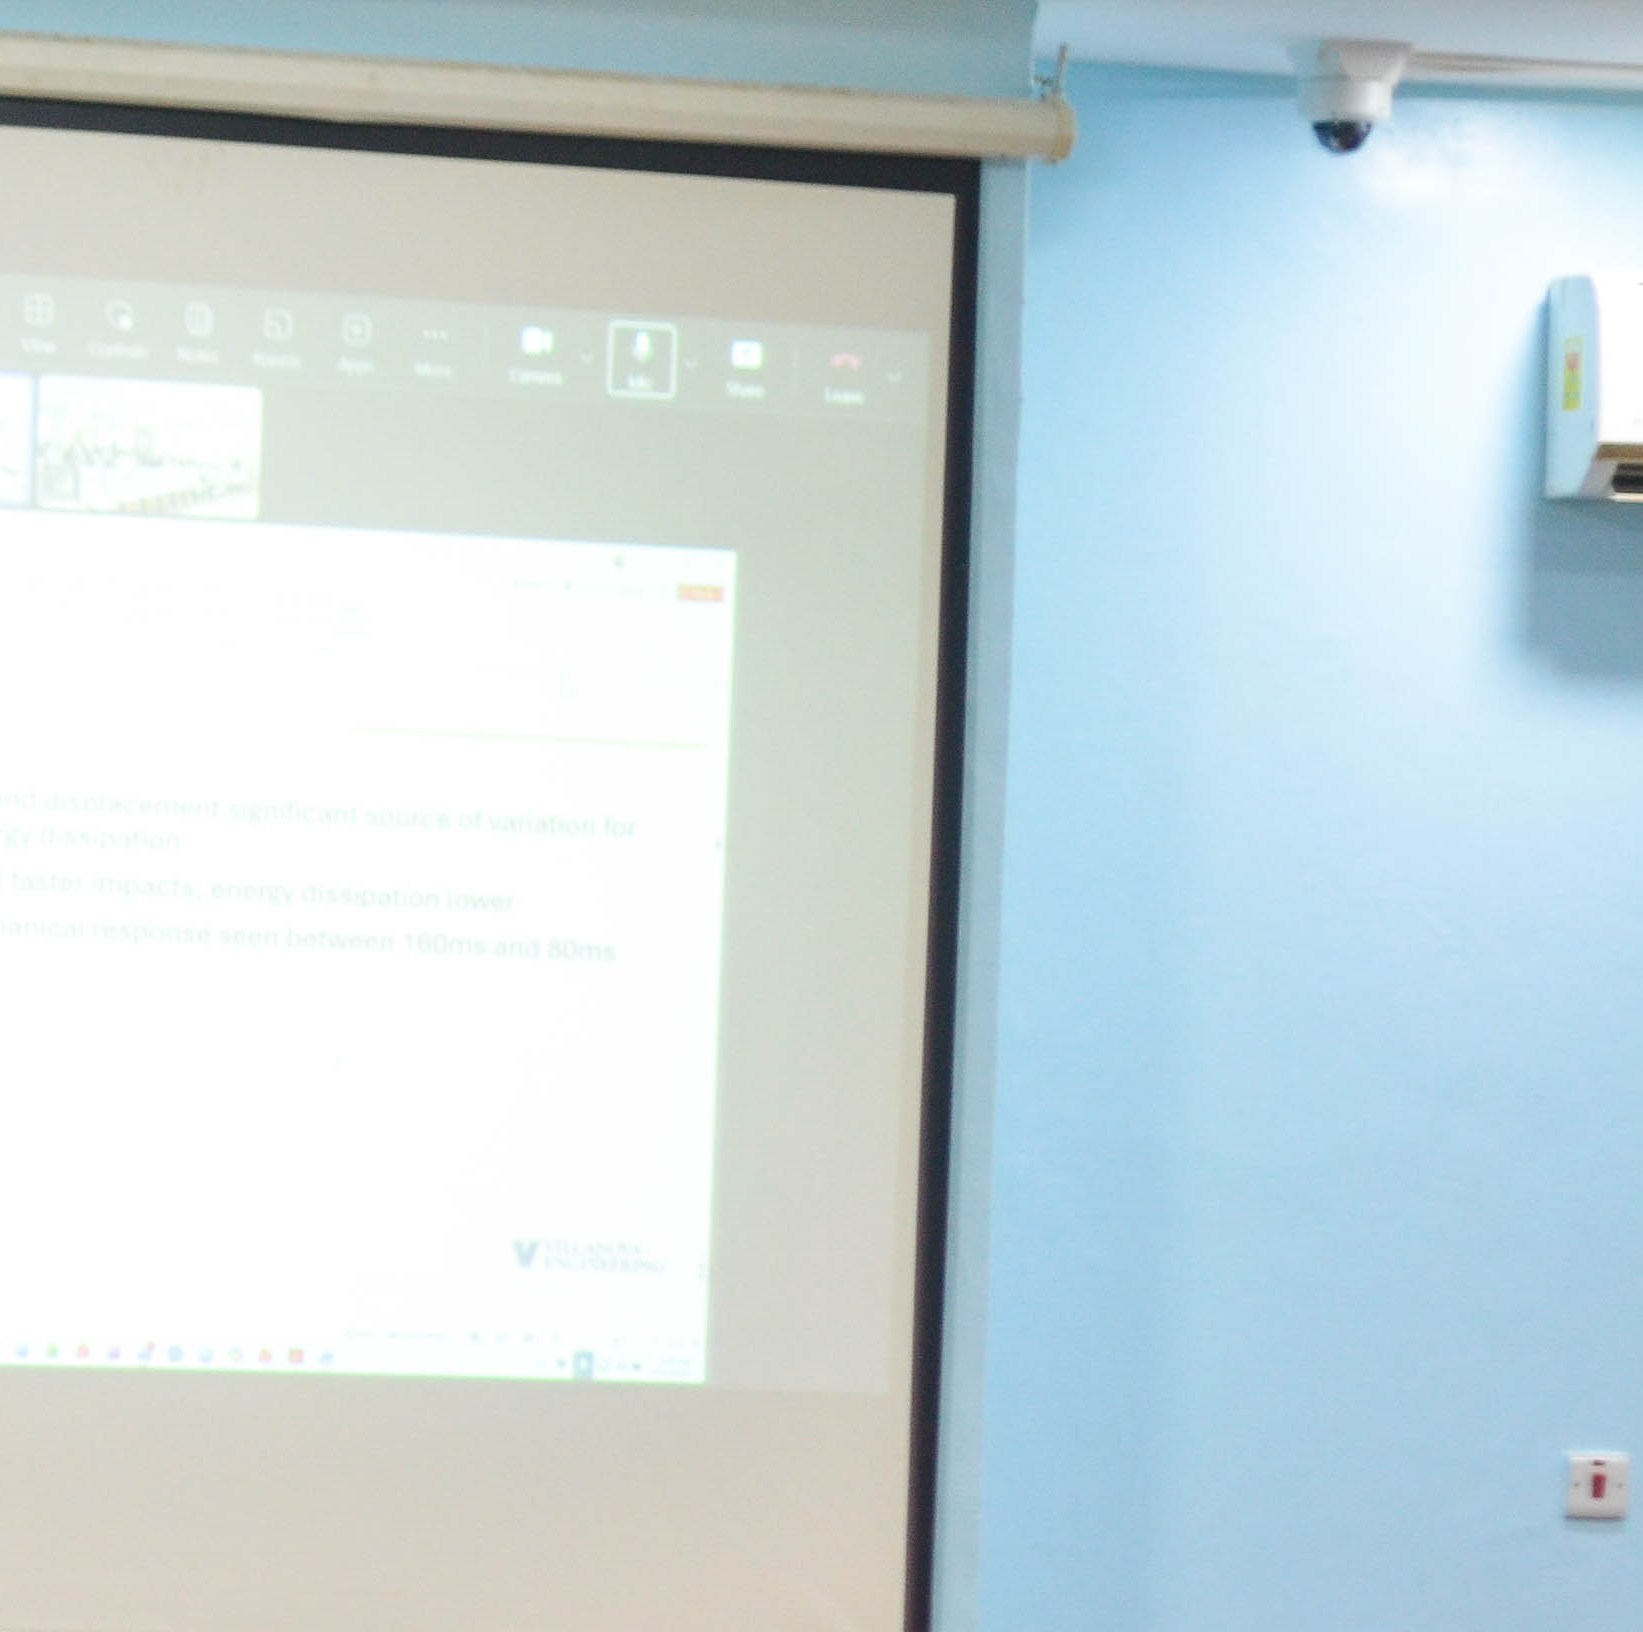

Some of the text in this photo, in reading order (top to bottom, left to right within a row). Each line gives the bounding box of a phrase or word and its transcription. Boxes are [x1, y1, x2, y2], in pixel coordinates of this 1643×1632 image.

[488, 809, 597, 837] variation
[603, 816, 636, 839] for
[211, 880, 293, 907] energy
[302, 883, 440, 909] dissipation
[447, 890, 515, 913] lower
[92, 918, 211, 945] response
[219, 925, 279, 946] seen
[285, 926, 394, 952] between
[493, 938, 540, 959] and
